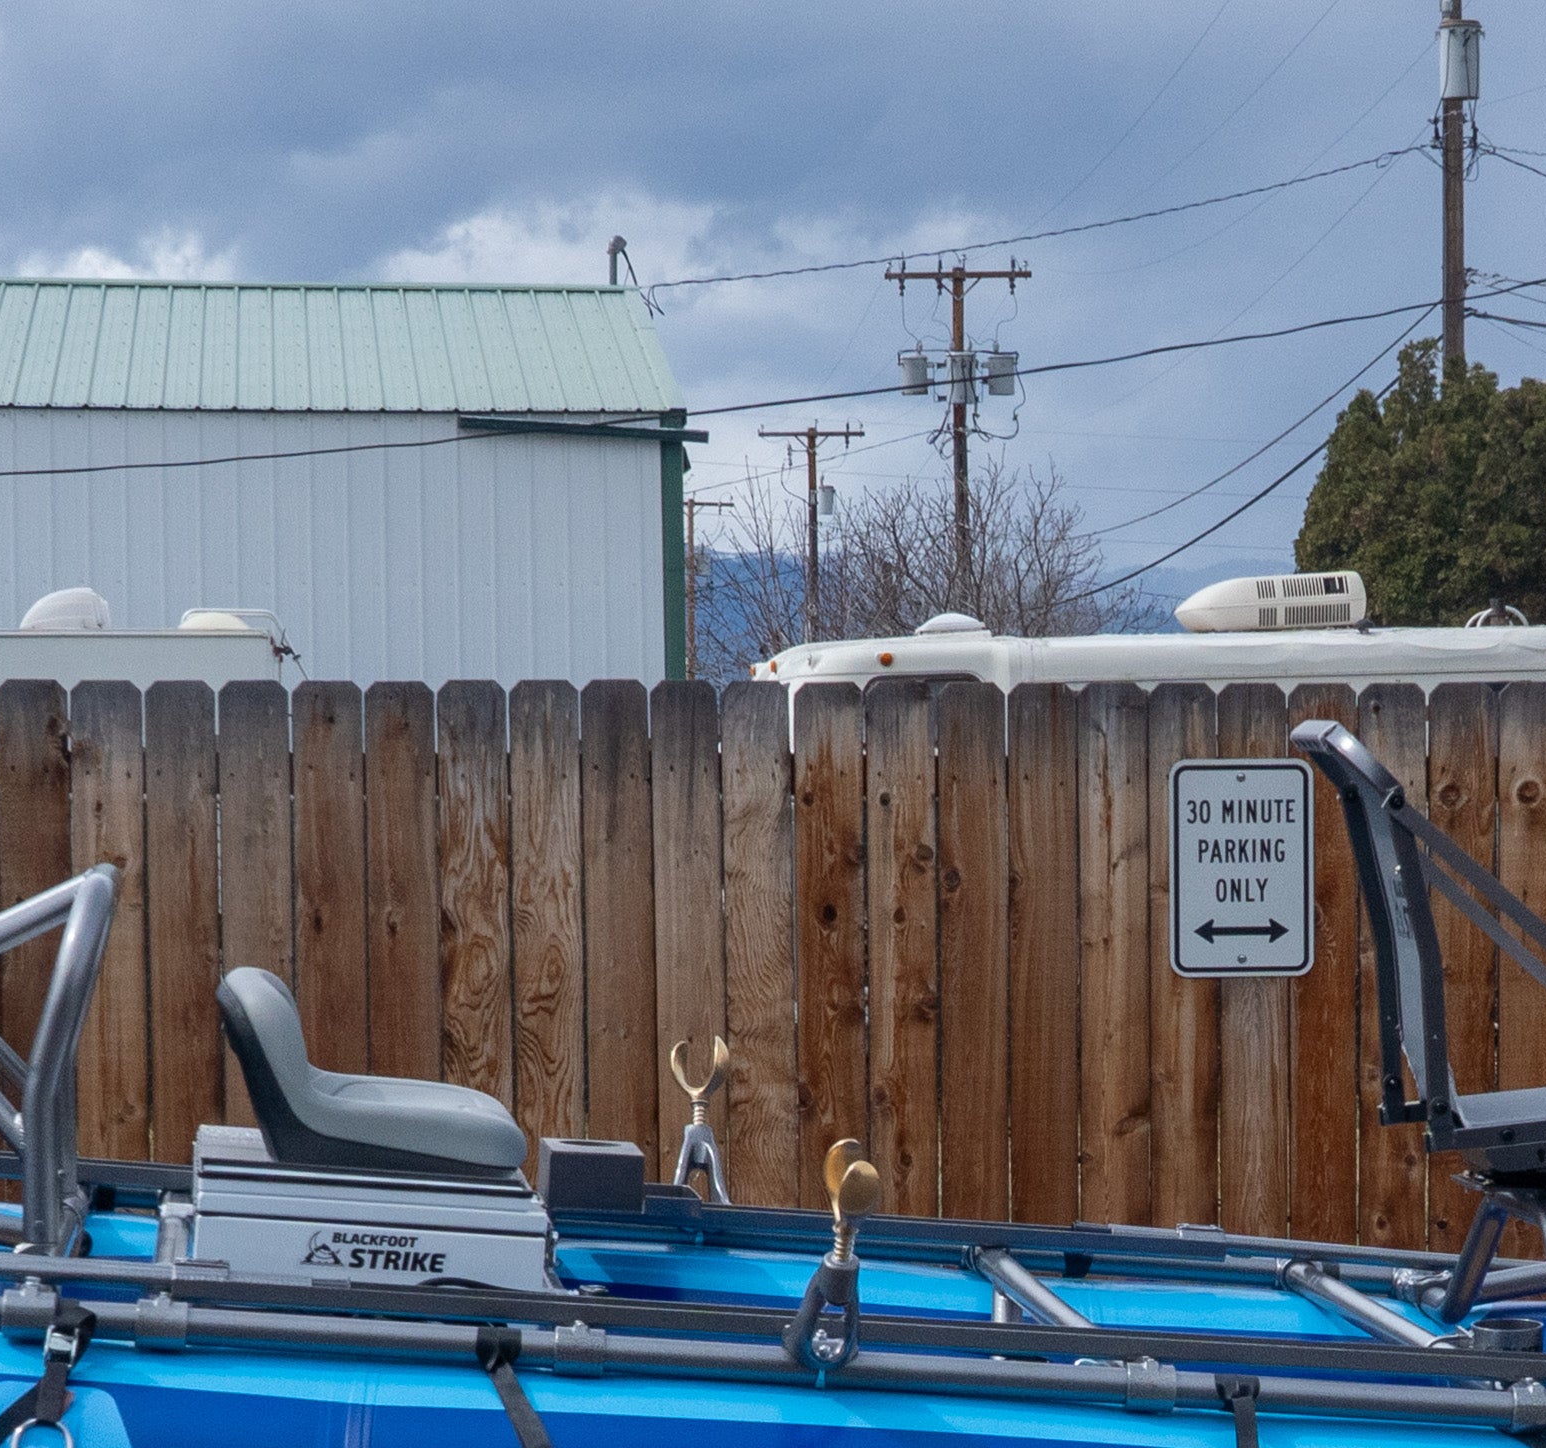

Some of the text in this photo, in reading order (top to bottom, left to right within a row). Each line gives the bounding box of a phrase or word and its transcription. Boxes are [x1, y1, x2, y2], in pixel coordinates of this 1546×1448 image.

[1186, 799, 1296, 824] 30 MINUTE
[1198, 838, 1286, 863] PARKING
[1215, 878, 1269, 903] ONLY
[331, 1232, 418, 1248] BLACKFOOT
[348, 1248, 447, 1273] STRIKE
